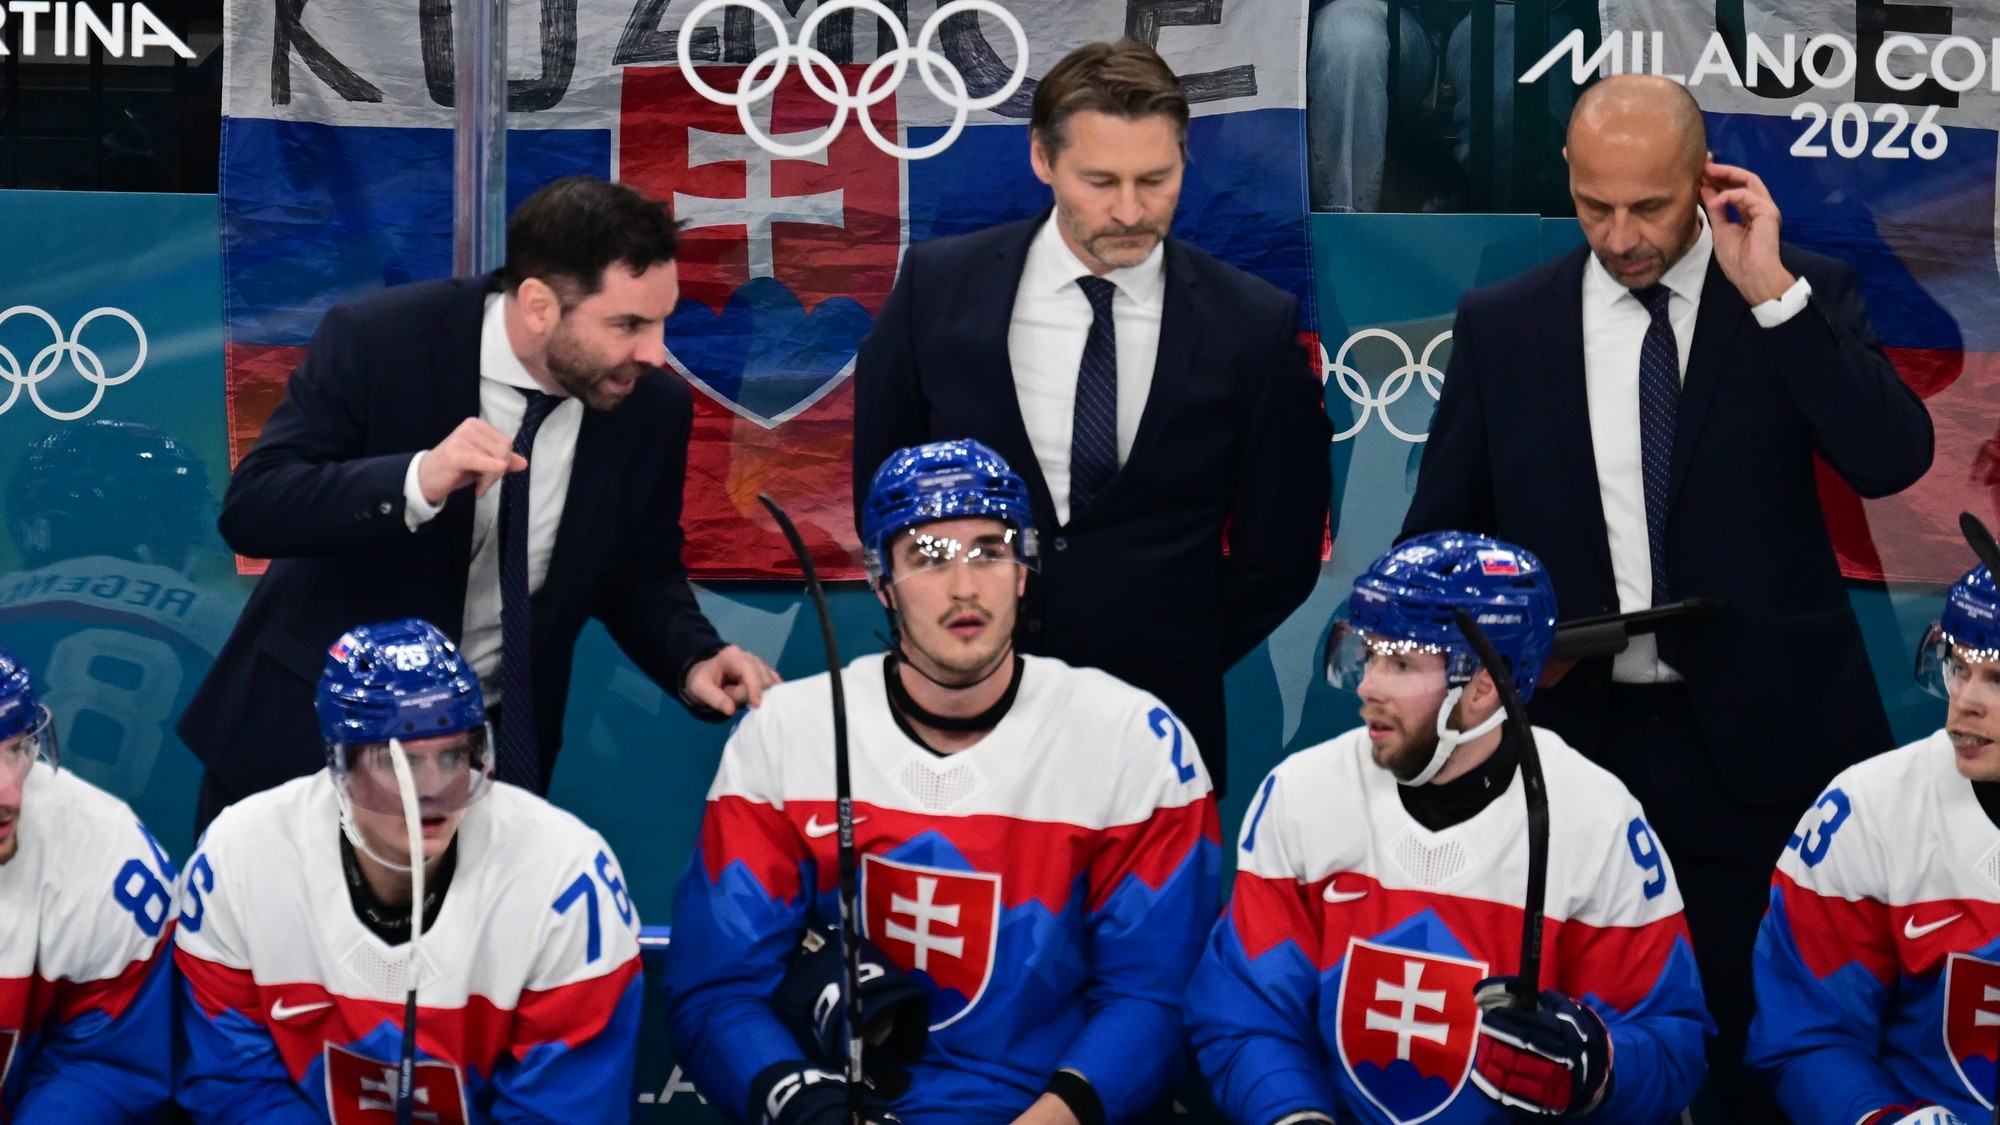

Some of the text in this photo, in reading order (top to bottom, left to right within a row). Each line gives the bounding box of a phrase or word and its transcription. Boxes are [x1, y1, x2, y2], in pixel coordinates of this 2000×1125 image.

[0, 1, 197, 58] TINA
[1518, 28, 2000, 92] MILANO CO
[1790, 102, 1948, 160] 2026
[1147, 706, 1196, 784] 2
[551, 848, 633, 965] 76
